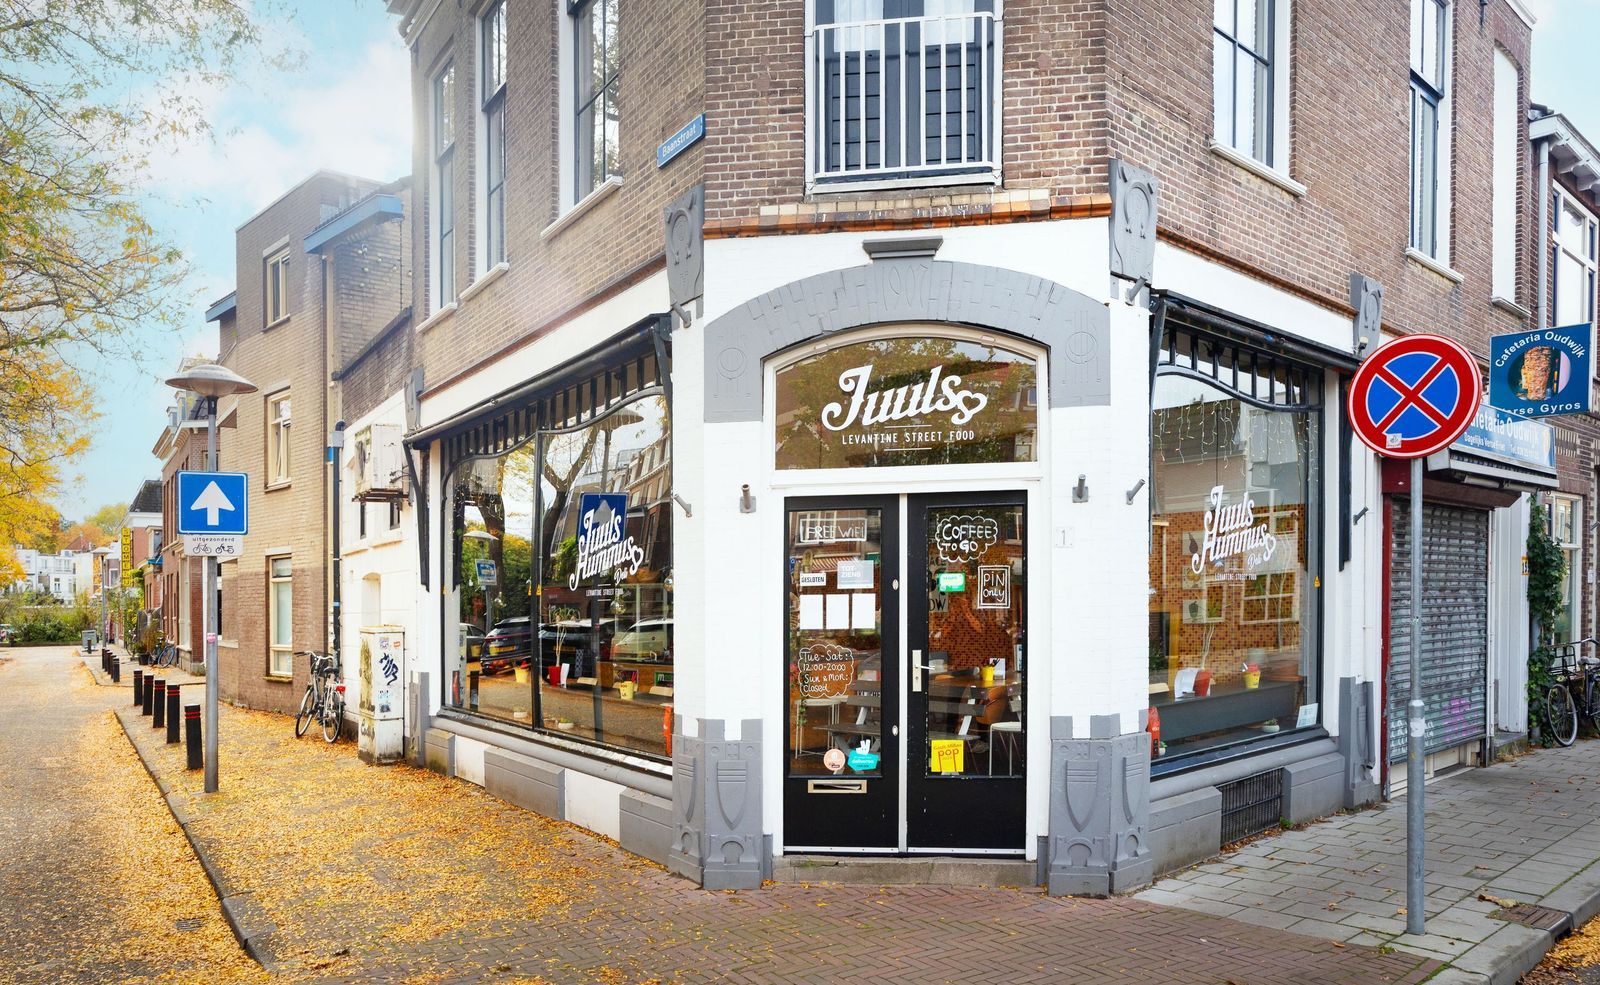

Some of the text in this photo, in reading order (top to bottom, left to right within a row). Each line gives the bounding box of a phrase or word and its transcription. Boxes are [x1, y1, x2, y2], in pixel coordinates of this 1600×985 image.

[662, 123, 697, 157] Baanstraat
[1495, 331, 1585, 367] Cafetaria Oudwijk
[821, 365, 968, 431] Juuls
[1540, 402, 1581, 414] Gyros
[842, 430, 975, 445] LEVANTINE STREET FOOD
[1204, 485, 1255, 534] Juuls
[579, 508, 622, 555] Juuls
[807, 525, 837, 539] FREE
[941, 540, 978, 553] TO GO
[942, 523, 992, 540] COFFEE
[1192, 524, 1272, 573] Hummus
[569, 536, 639, 591] Hummus
[804, 673, 820, 684] Sun
